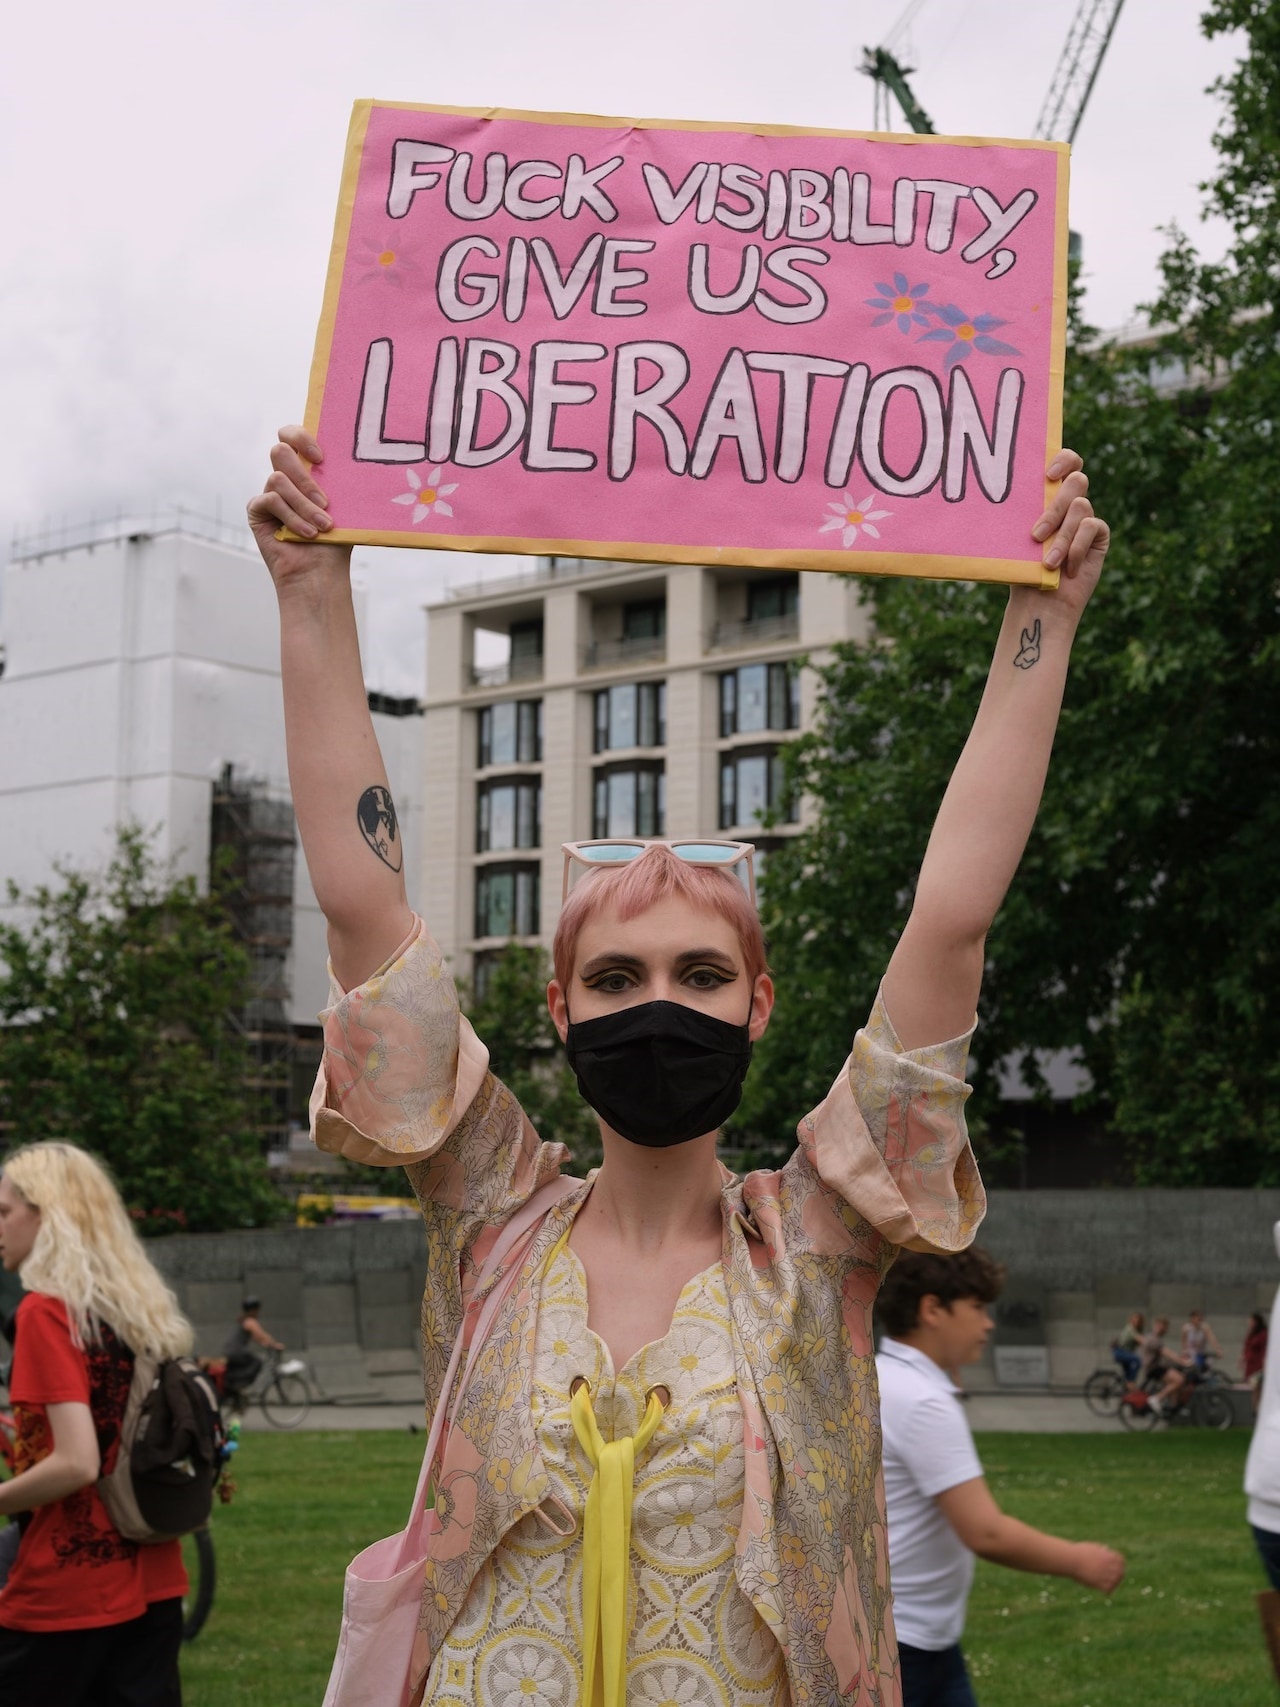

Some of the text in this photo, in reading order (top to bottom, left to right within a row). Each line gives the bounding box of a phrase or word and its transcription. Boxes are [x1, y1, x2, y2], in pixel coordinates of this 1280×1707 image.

[386, 138, 1037, 279] FUCK VISIBILITY,
[436, 234, 830, 324] GIVE US
[353, 337, 1025, 503] LIBERATION
